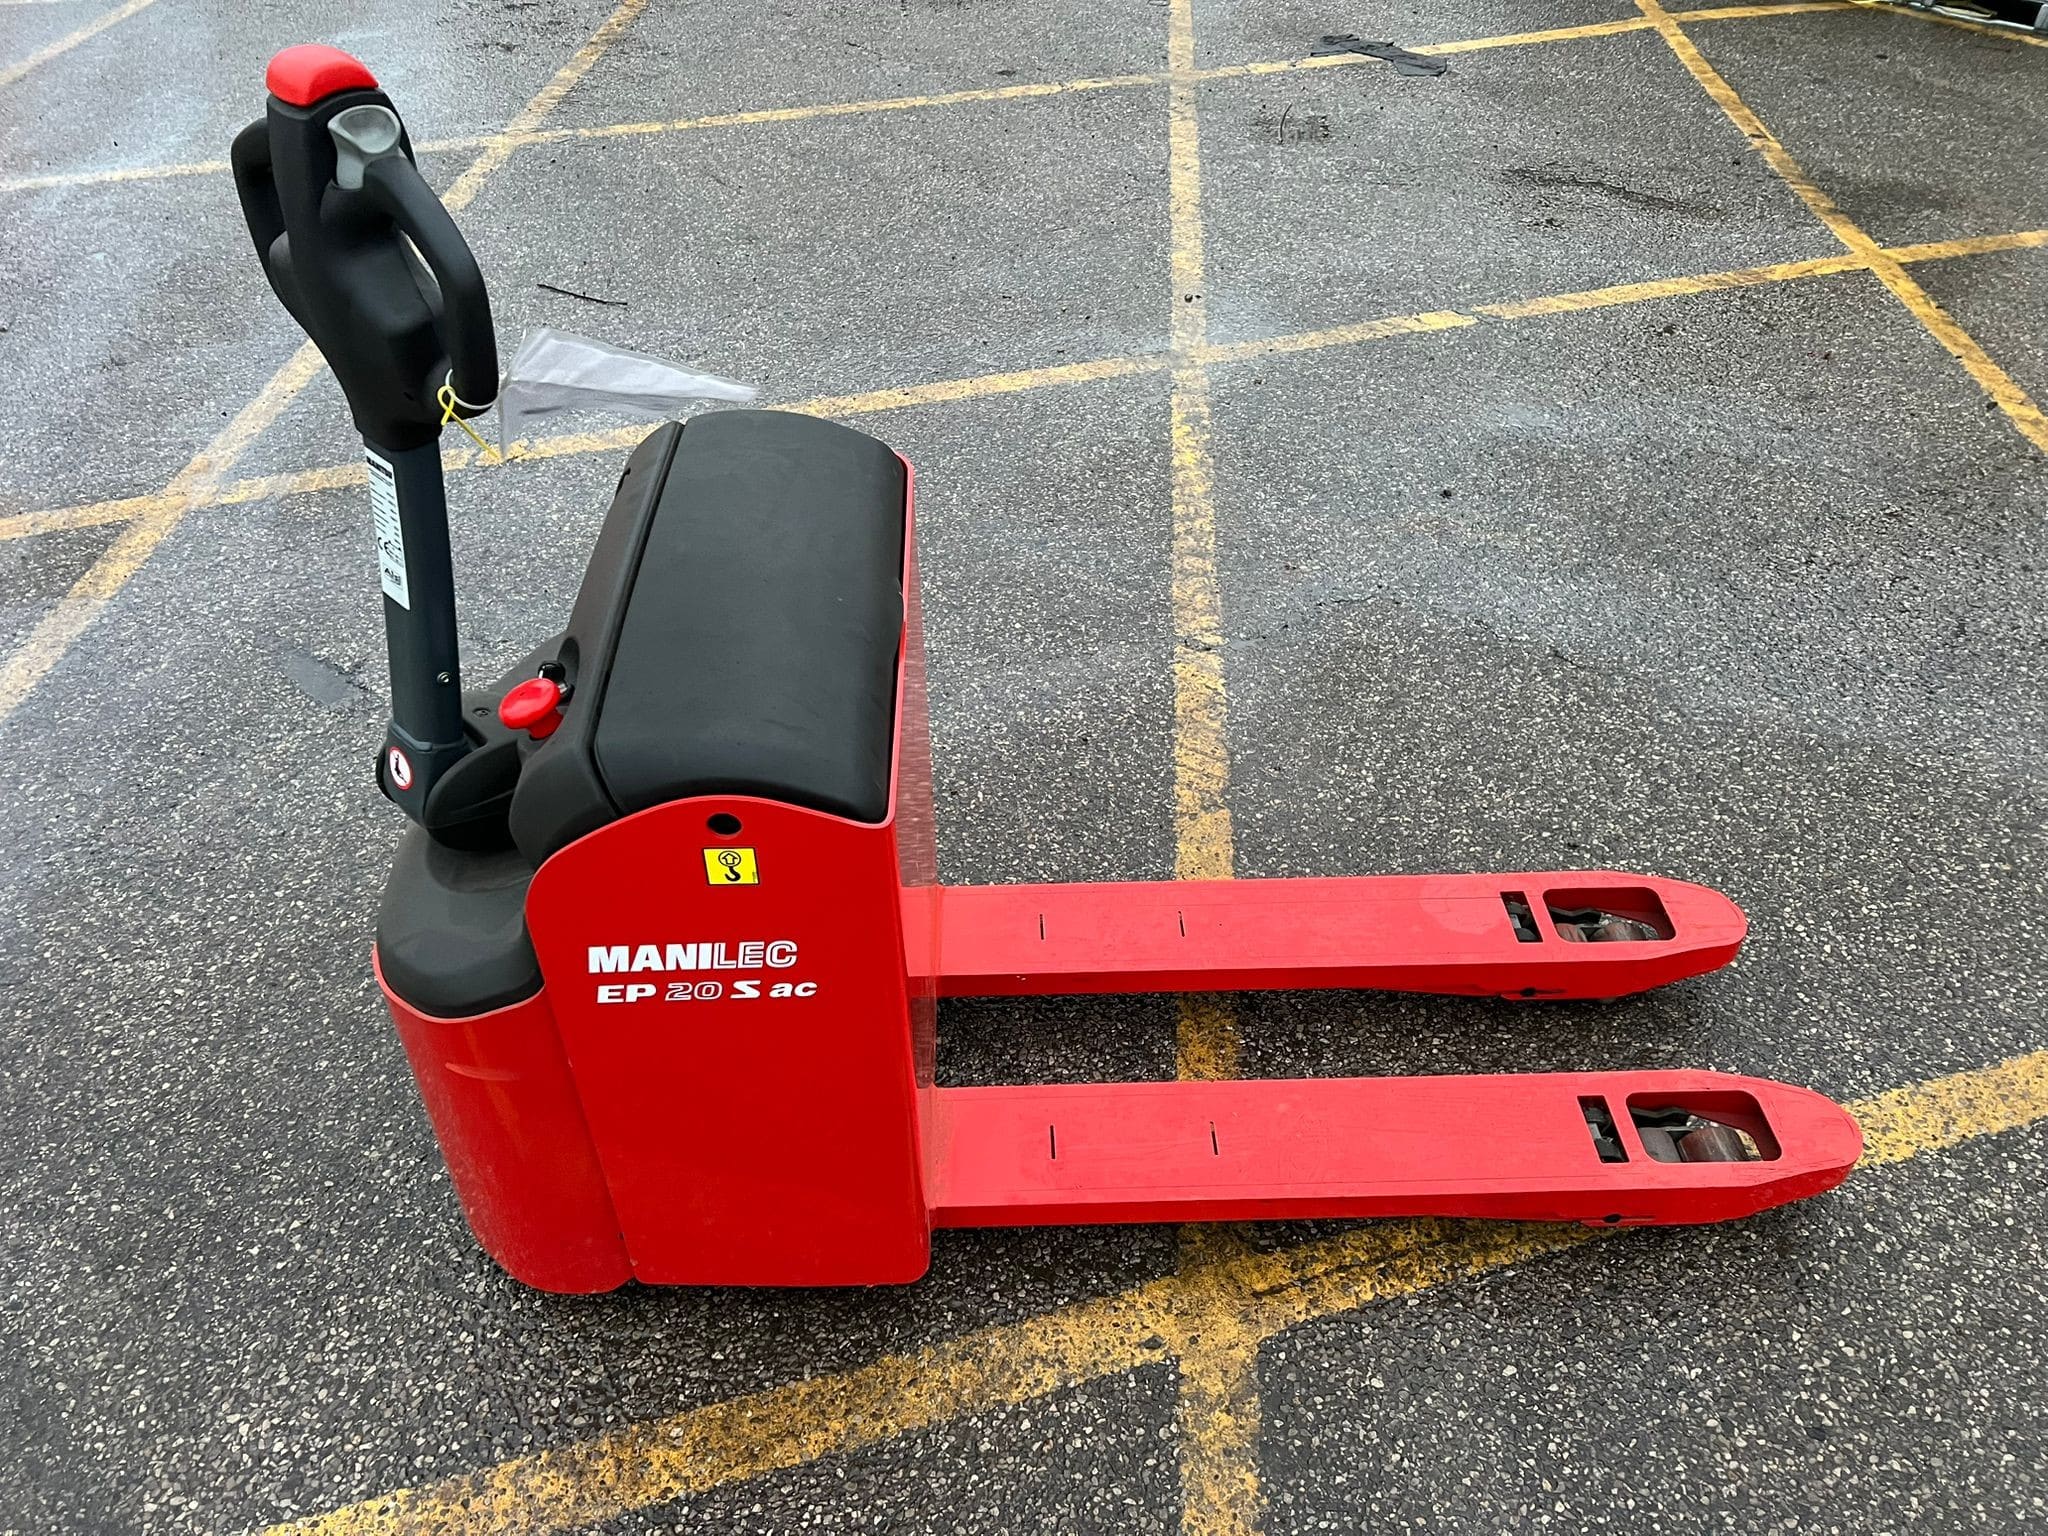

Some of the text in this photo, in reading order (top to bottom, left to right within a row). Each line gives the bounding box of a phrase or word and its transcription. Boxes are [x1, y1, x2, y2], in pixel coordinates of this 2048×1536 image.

[588, 940, 798, 974] MANILEC
[596, 979, 818, 1004] EP 20 S ac
